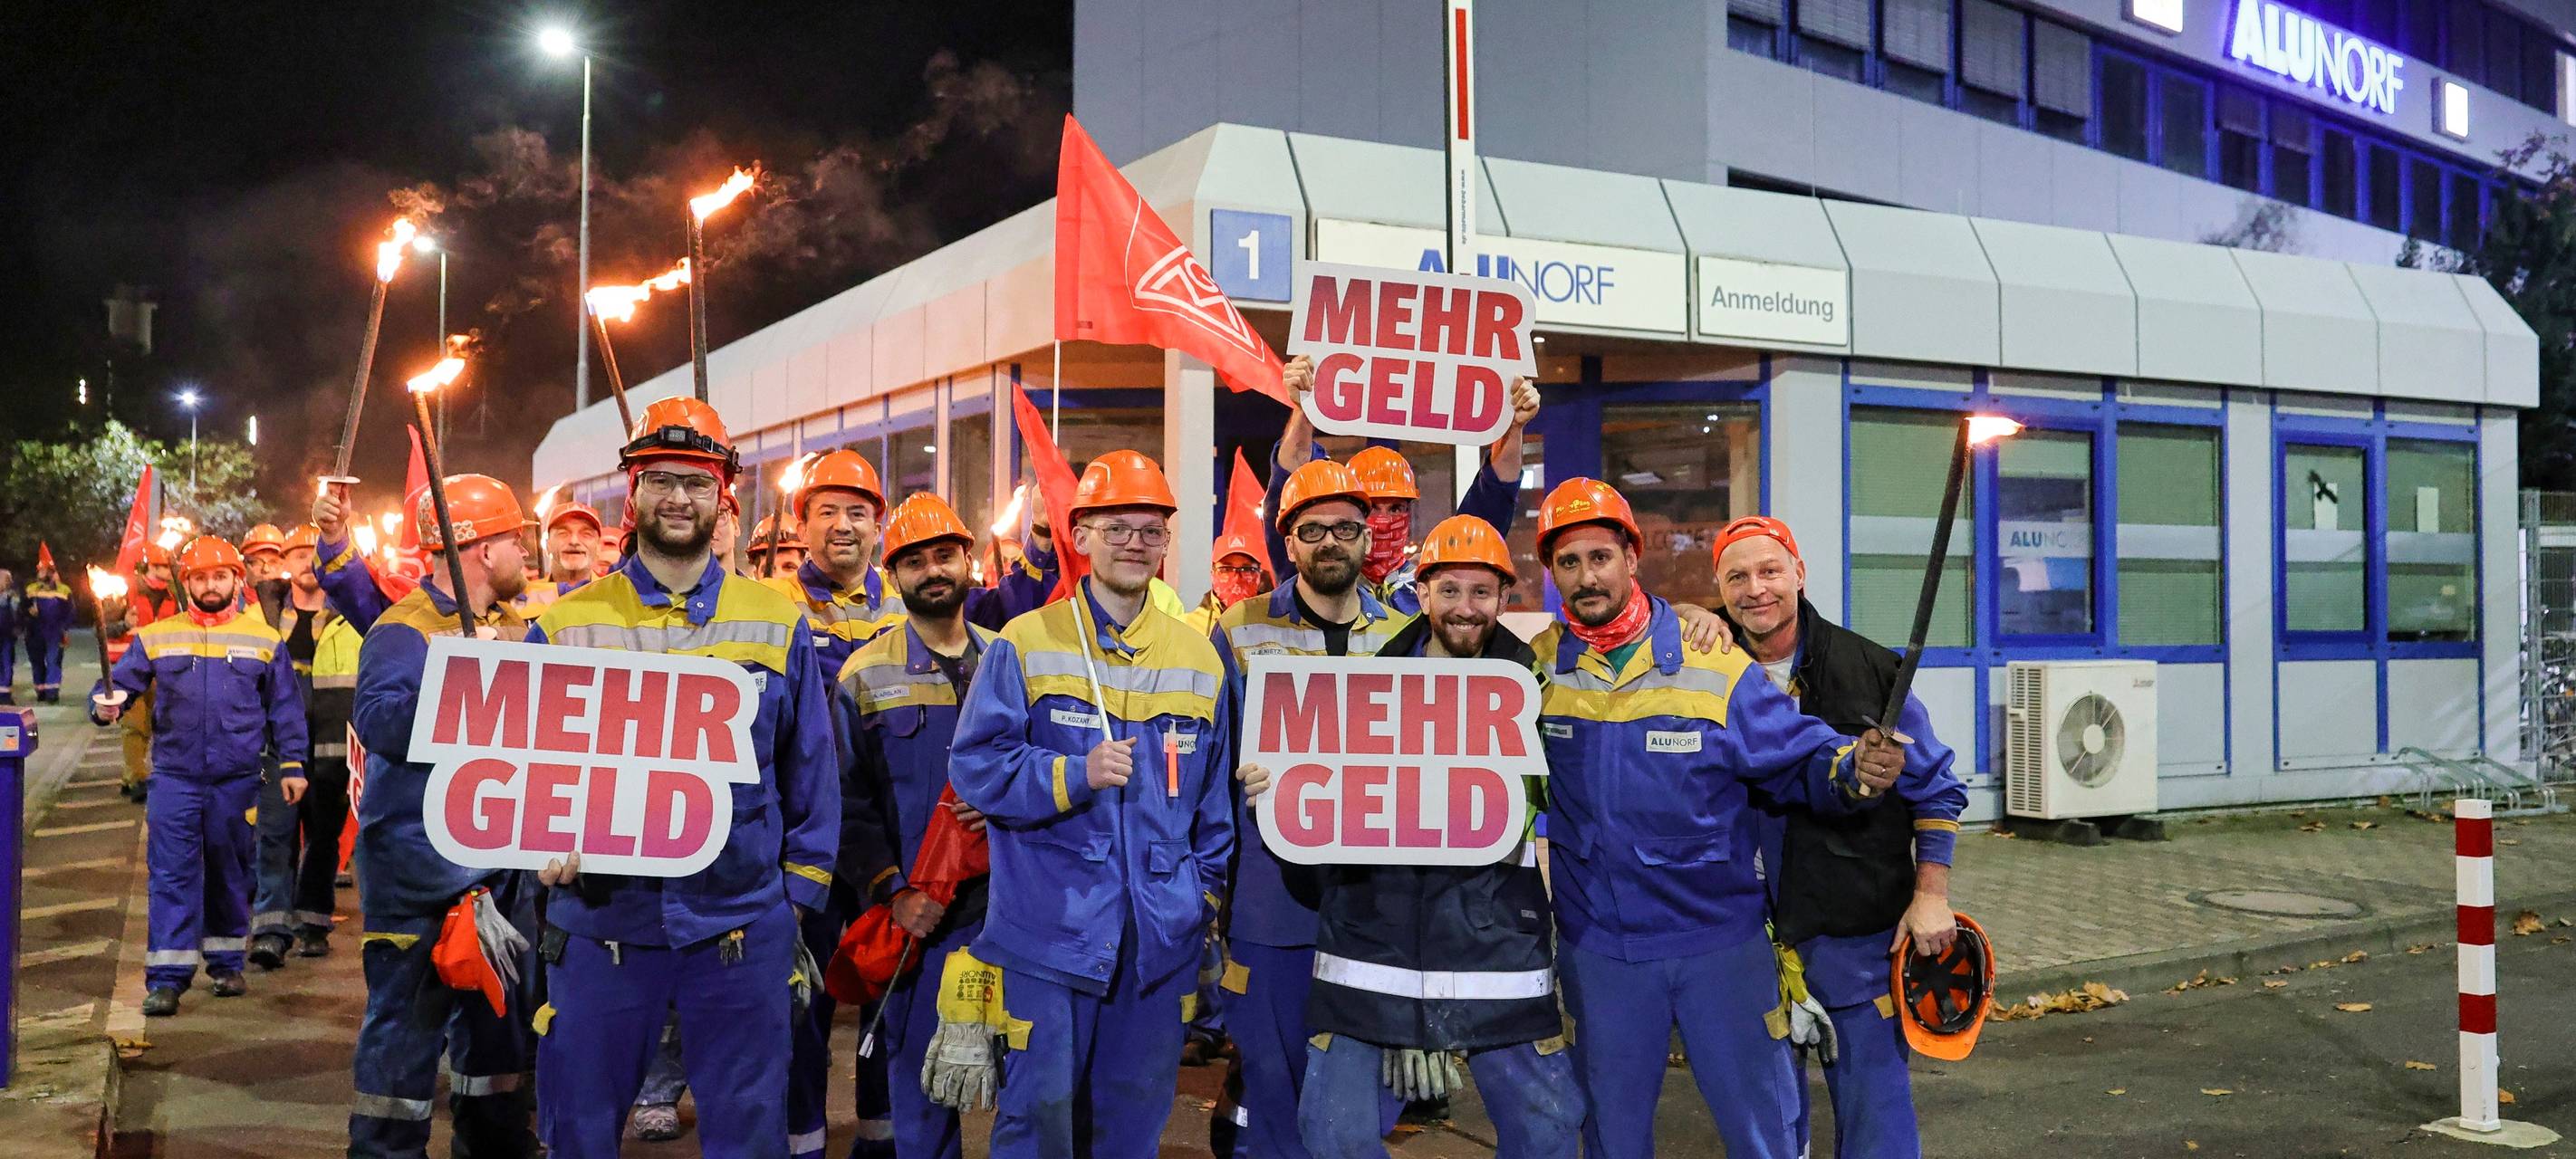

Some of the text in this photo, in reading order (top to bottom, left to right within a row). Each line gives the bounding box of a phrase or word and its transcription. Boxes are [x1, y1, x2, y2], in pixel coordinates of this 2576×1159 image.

[2231, 0, 2404, 115] ALUNORF
[1238, 230, 1259, 280] 1
[1418, 248, 1615, 305] AUNORF
[1303, 274, 1523, 360] MEHR
[1711, 285, 1834, 322] Anmeldung
[1313, 352, 1504, 433] GELD
[431, 655, 741, 763] MEHR
[1258, 672, 1527, 757] MEHR
[1651, 737, 1697, 747] ALUNORF
[444, 758, 715, 859] GELD
[1274, 763, 1509, 848] GELD
